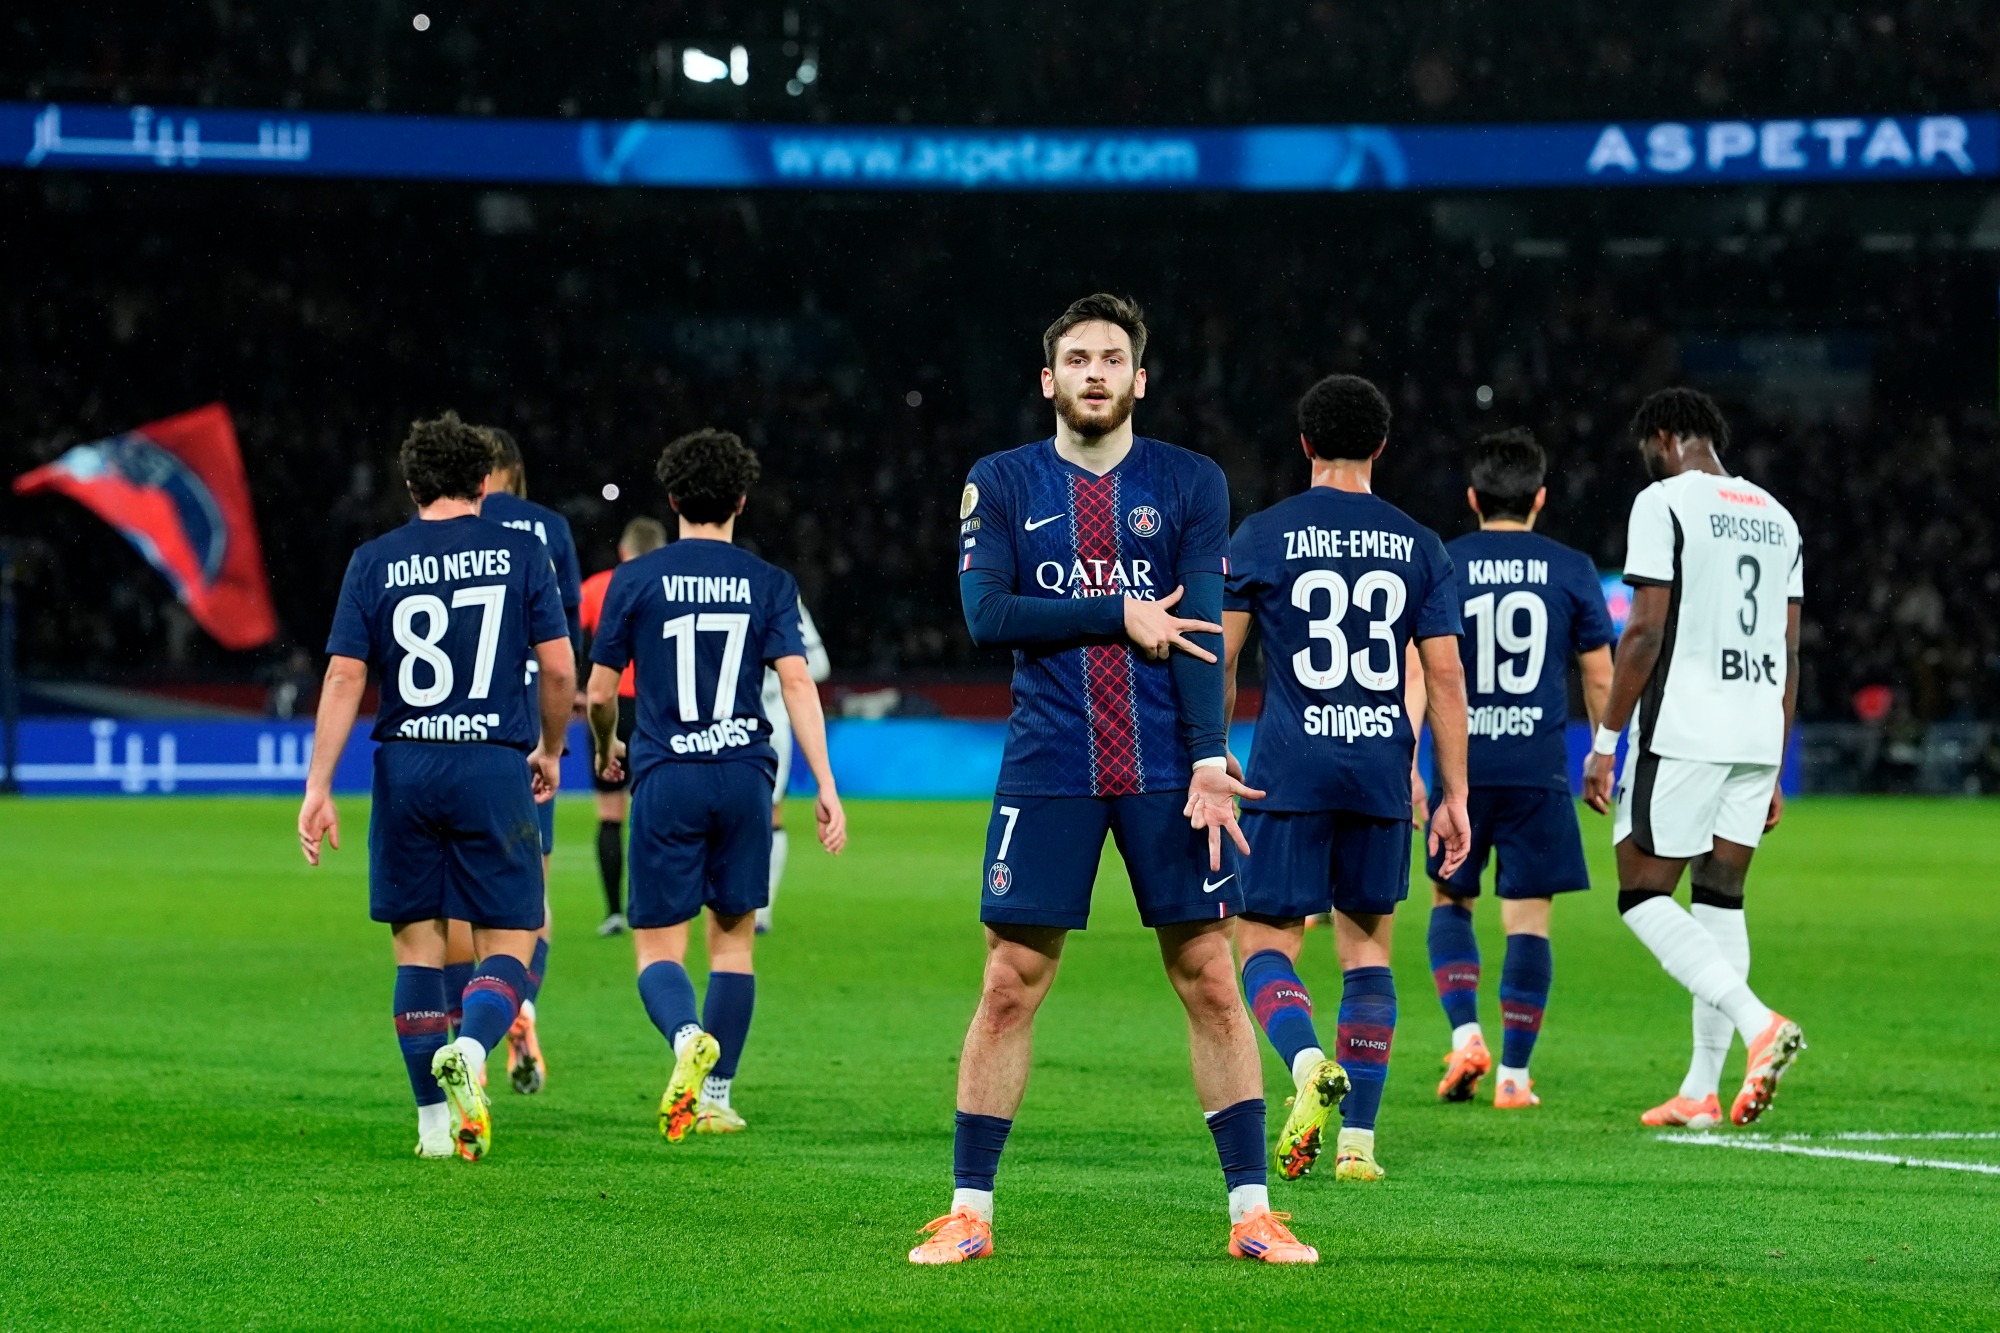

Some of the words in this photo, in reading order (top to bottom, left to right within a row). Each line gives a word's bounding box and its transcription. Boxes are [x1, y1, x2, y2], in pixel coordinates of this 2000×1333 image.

[772, 135, 1197, 187] www.aspetar.com
[1587, 115, 1975, 174] ASPETAR
[1284, 525, 1415, 563] ZAÏRE-EMERY
[1710, 514, 1787, 547] BRASSIER
[385, 554, 439, 589] JOÃO
[444, 549, 511, 582] NEVES
[1036, 558, 1154, 595] QATAR
[1468, 559, 1520, 585] KANG
[1527, 559, 1548, 585] IN
[662, 575, 751, 604] VITINHA
[1737, 555, 1761, 637] 3
[392, 584, 507, 708] 87
[1291, 569, 1407, 691] 33
[1464, 590, 1549, 695] 19
[662, 613, 751, 723] 17
[670, 718, 751, 755] snipes
[1303, 704, 1393, 743] snipes
[1467, 705, 1534, 740] snipes
[996, 805, 1021, 861] 7
[1351, 1039, 1387, 1051] PARIS
